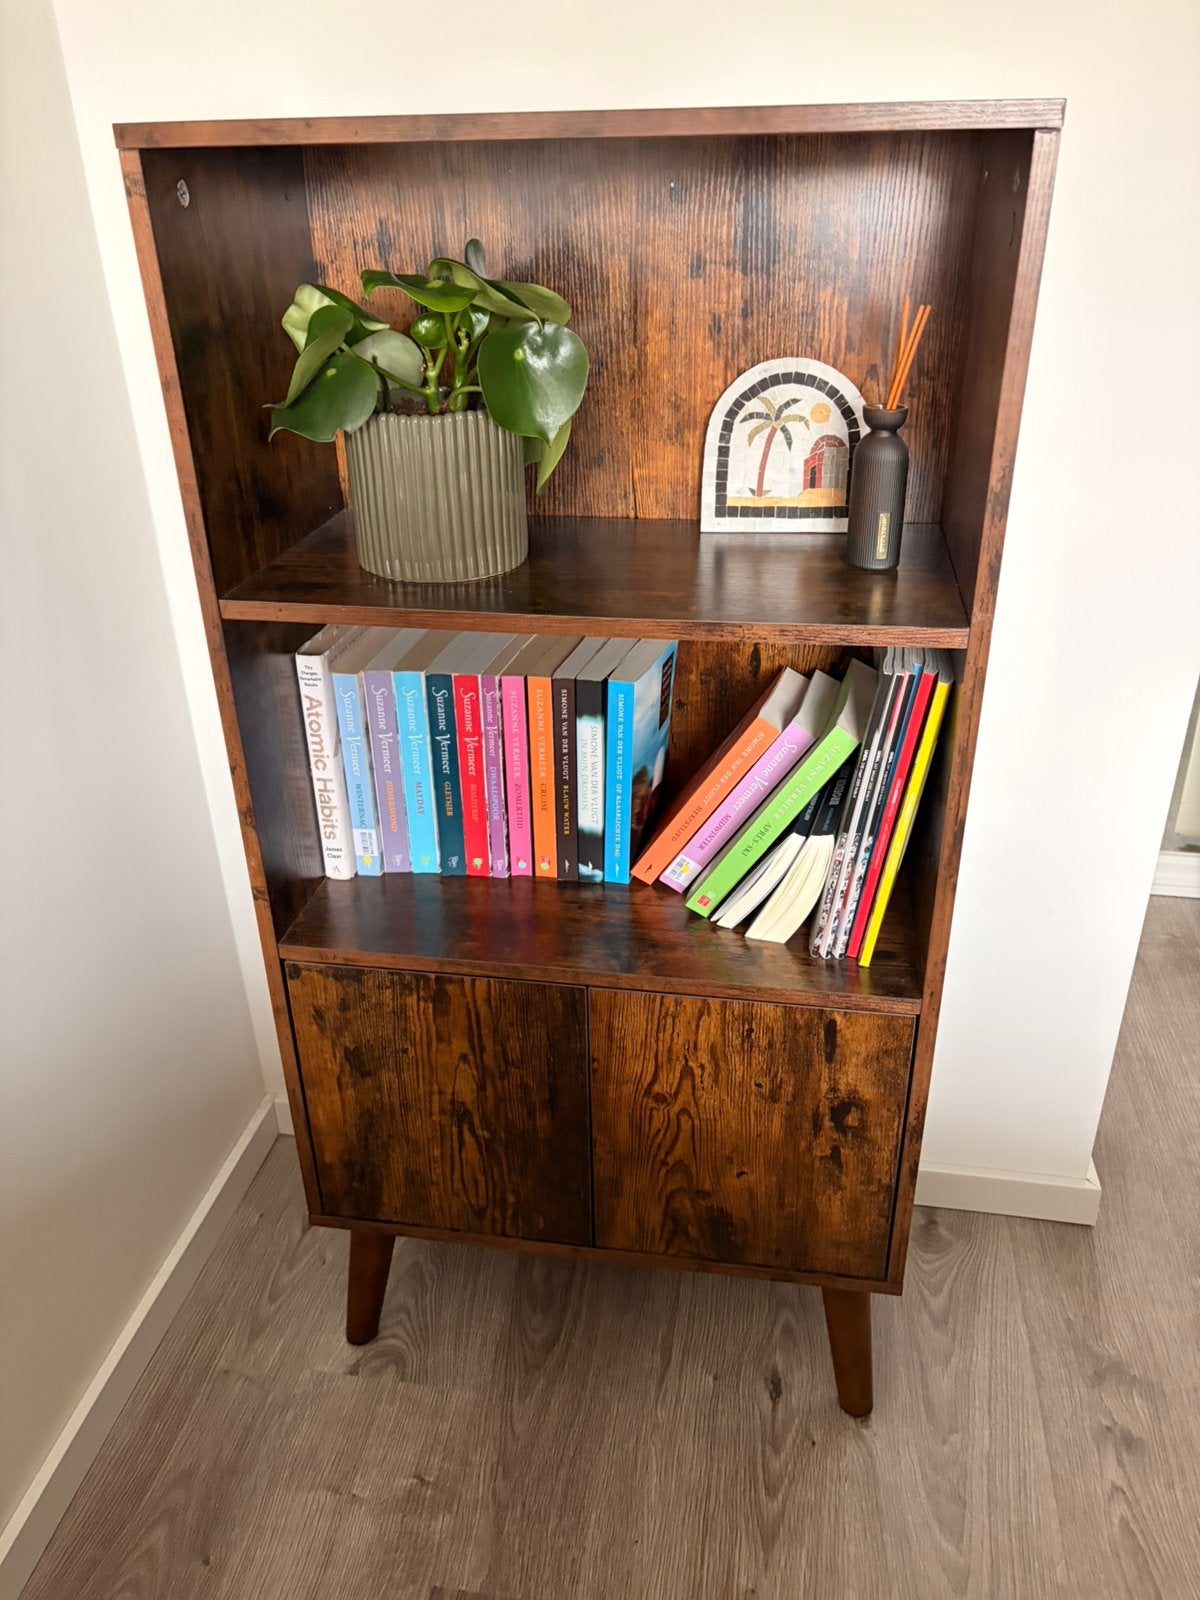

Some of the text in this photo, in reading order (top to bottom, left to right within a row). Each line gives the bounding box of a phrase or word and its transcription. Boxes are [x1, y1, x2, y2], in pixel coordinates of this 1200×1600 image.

[340, 688, 355, 733] Suzanne
[371, 685, 388, 730] Suzanne
[460, 688, 476, 733] Suzanne
[346, 736, 362, 777] Vermeer
[377, 732, 393, 774] Vermeer
[402, 686, 425, 816] Suzanne Vermeer MAYDAY
[432, 686, 454, 816] Suzanne Vermeer GLETSJER
[463, 735, 478, 776] Vermeer
[484, 688, 499, 820] Suzanne Vermeer DWAALSPOOR
[510, 691, 523, 829] SUZANNE VERMEER ZOMERTIJD
[536, 688, 548, 812] SUZANNE VERMEER CRUISE
[590, 725, 598, 758] SIMONE
[742, 732, 765, 756] SIMONE
[304, 694, 338, 840] Atomic Habits
[721, 771, 733, 784] DER
[731, 758, 743, 771] VAN
[806, 743, 840, 784] SUZANNE
[616, 784, 622, 794] OP
[699, 735, 797, 851] Suzanne Vermeer MIDWINTER
[703, 783, 722, 805] VLUGT
[774, 784, 806, 820] VERMEER
[671, 806, 703, 842] HERFSTLIED
